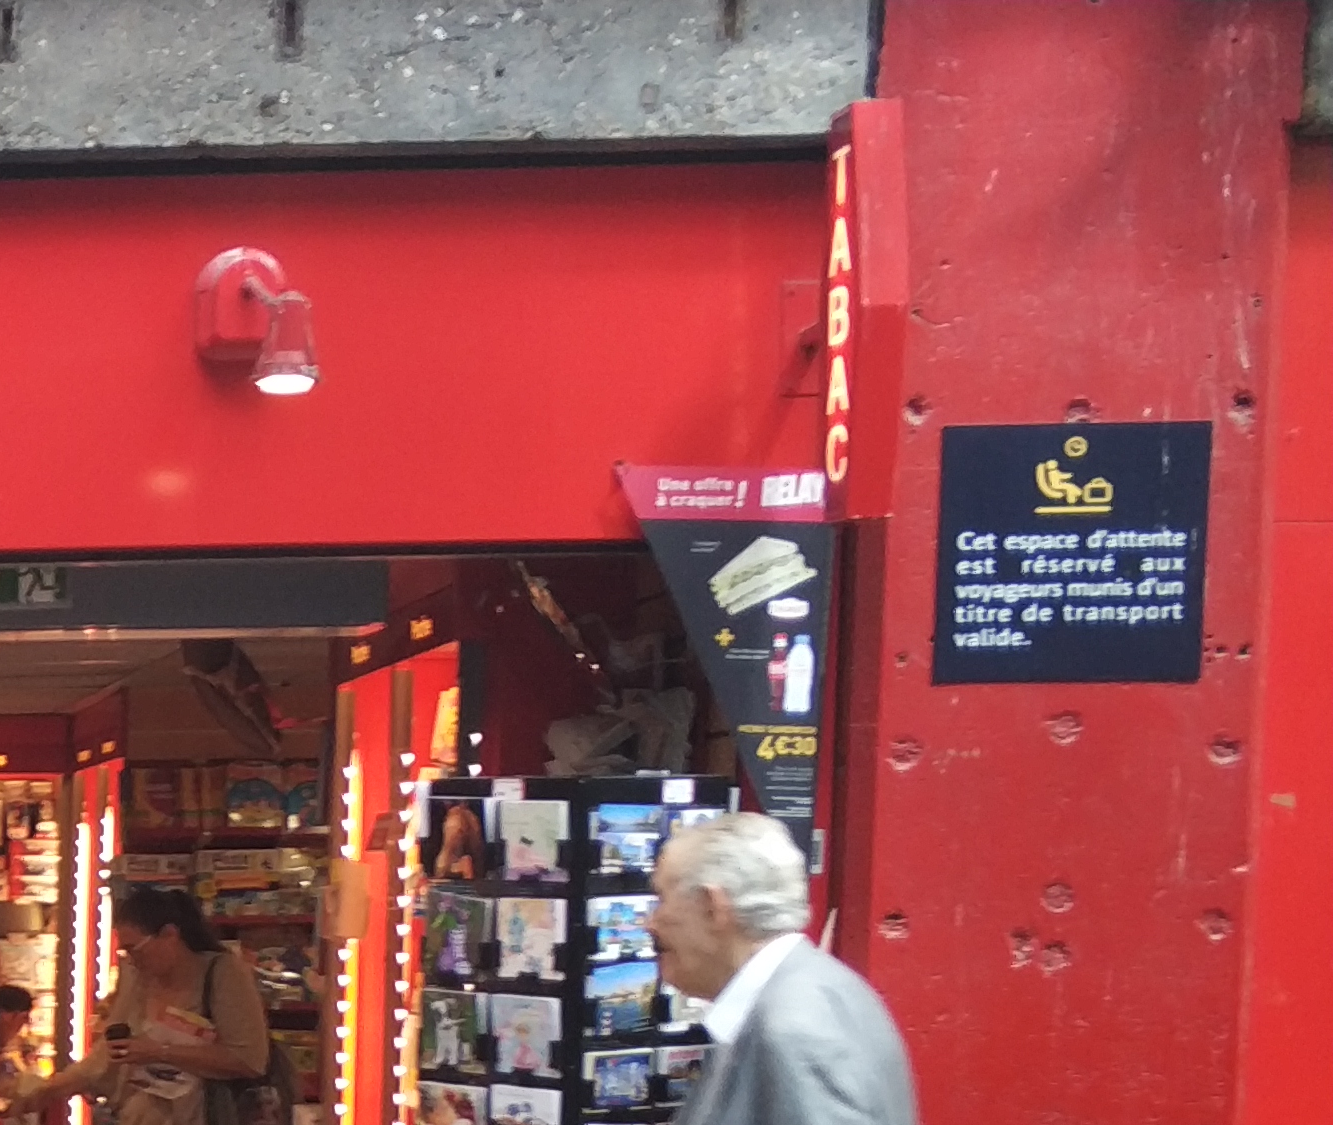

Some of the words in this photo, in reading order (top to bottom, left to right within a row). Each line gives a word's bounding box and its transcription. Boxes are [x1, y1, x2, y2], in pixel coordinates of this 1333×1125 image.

[825, 144, 852, 482] TABAC
[657, 478, 691, 490] Une
[693, 477, 734, 490] offre
[669, 495, 734, 509] craquer
[956, 531, 997, 551] Cet
[1003, 533, 1080, 554] espace
[1086, 529, 1187, 549] d'attente
[955, 557, 997, 575] est
[1020, 554, 1116, 574] réservé
[1139, 557, 1186, 572] aux
[954, 582, 1064, 603] voyageurs
[1067, 578, 1133, 597] munis
[1136, 577, 1184, 596] d'un
[954, 604, 1013, 623] titre
[1021, 603, 1054, 622] de
[1062, 603, 1183, 624] transport
[952, 629, 1032, 647] valide.
